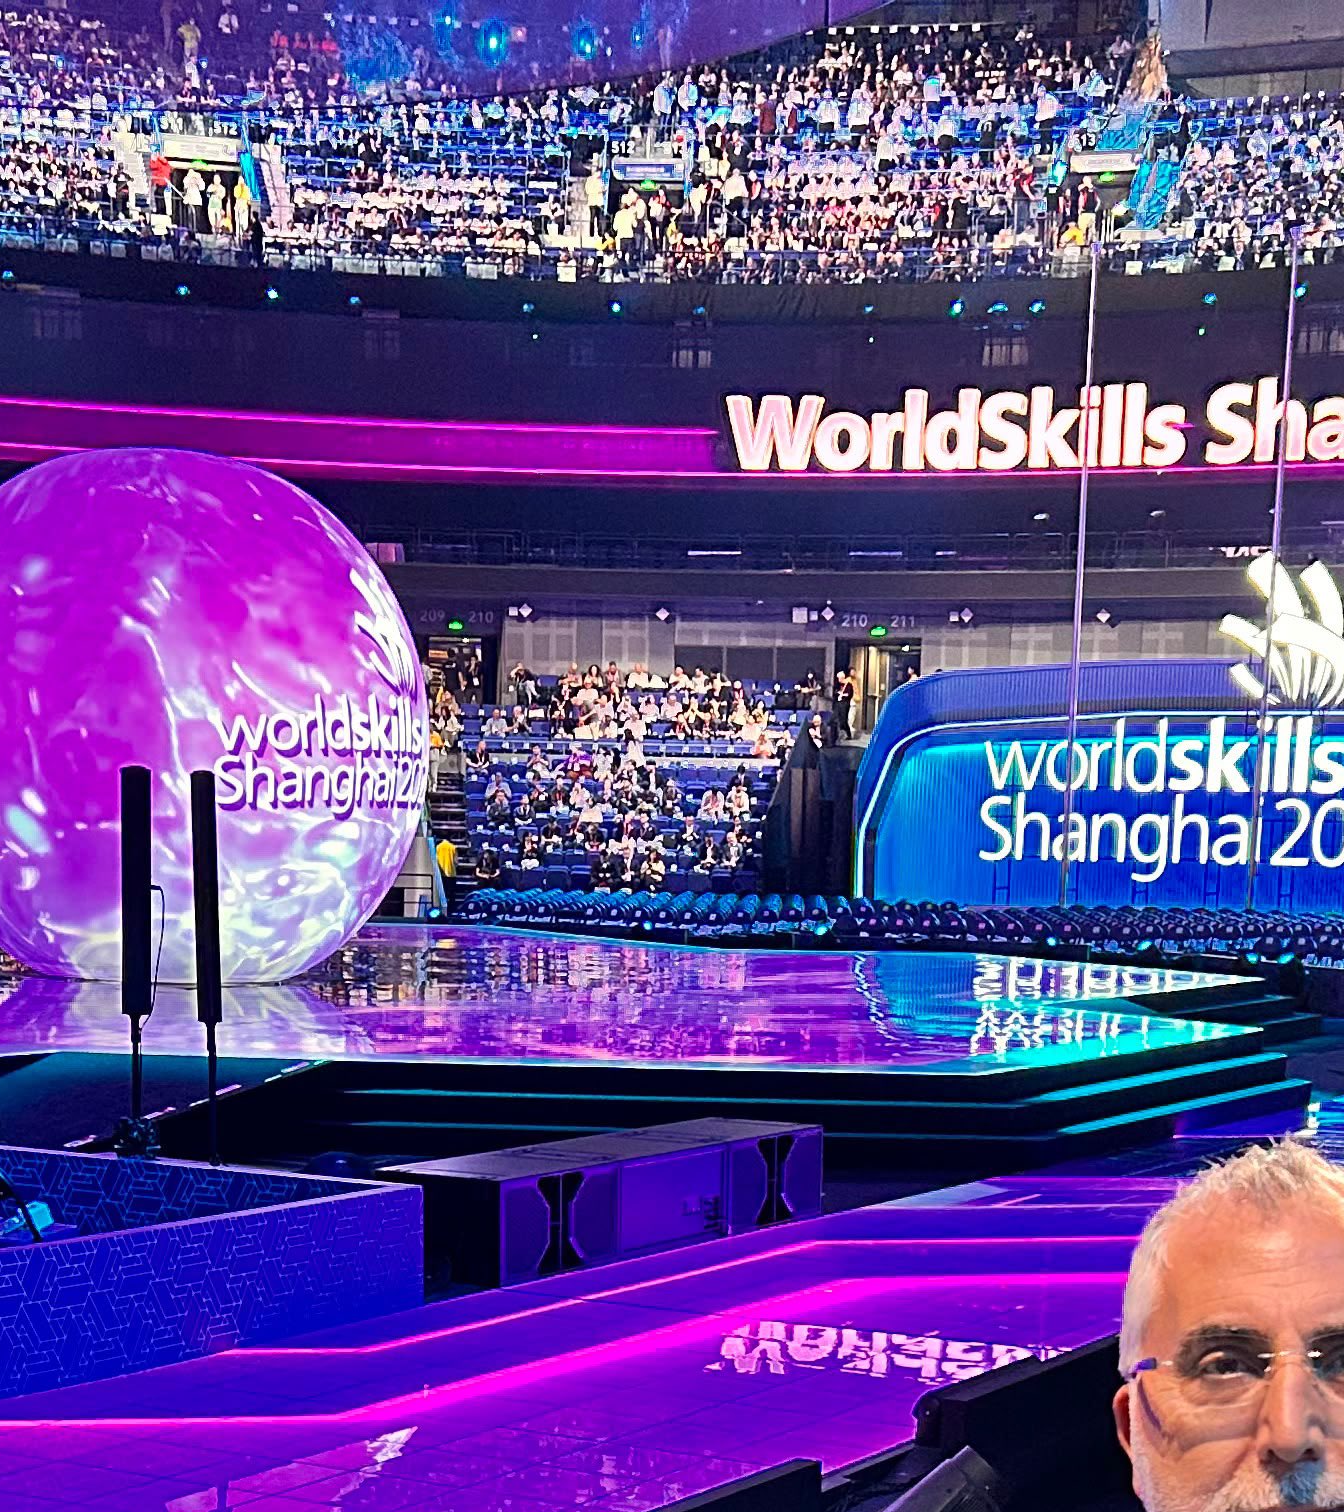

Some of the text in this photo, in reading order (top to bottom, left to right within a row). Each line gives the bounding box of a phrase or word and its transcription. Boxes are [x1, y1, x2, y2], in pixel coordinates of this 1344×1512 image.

[214, 121, 238, 135] 512
[611, 141, 635, 154] 512
[725, 384, 1188, 471] WorldSkills
[420, 609, 446, 622] 209
[468, 610, 494, 624] 210
[841, 614, 868, 628] 210
[890, 614, 916, 628] 211
[214, 693, 424, 755] worldskills
